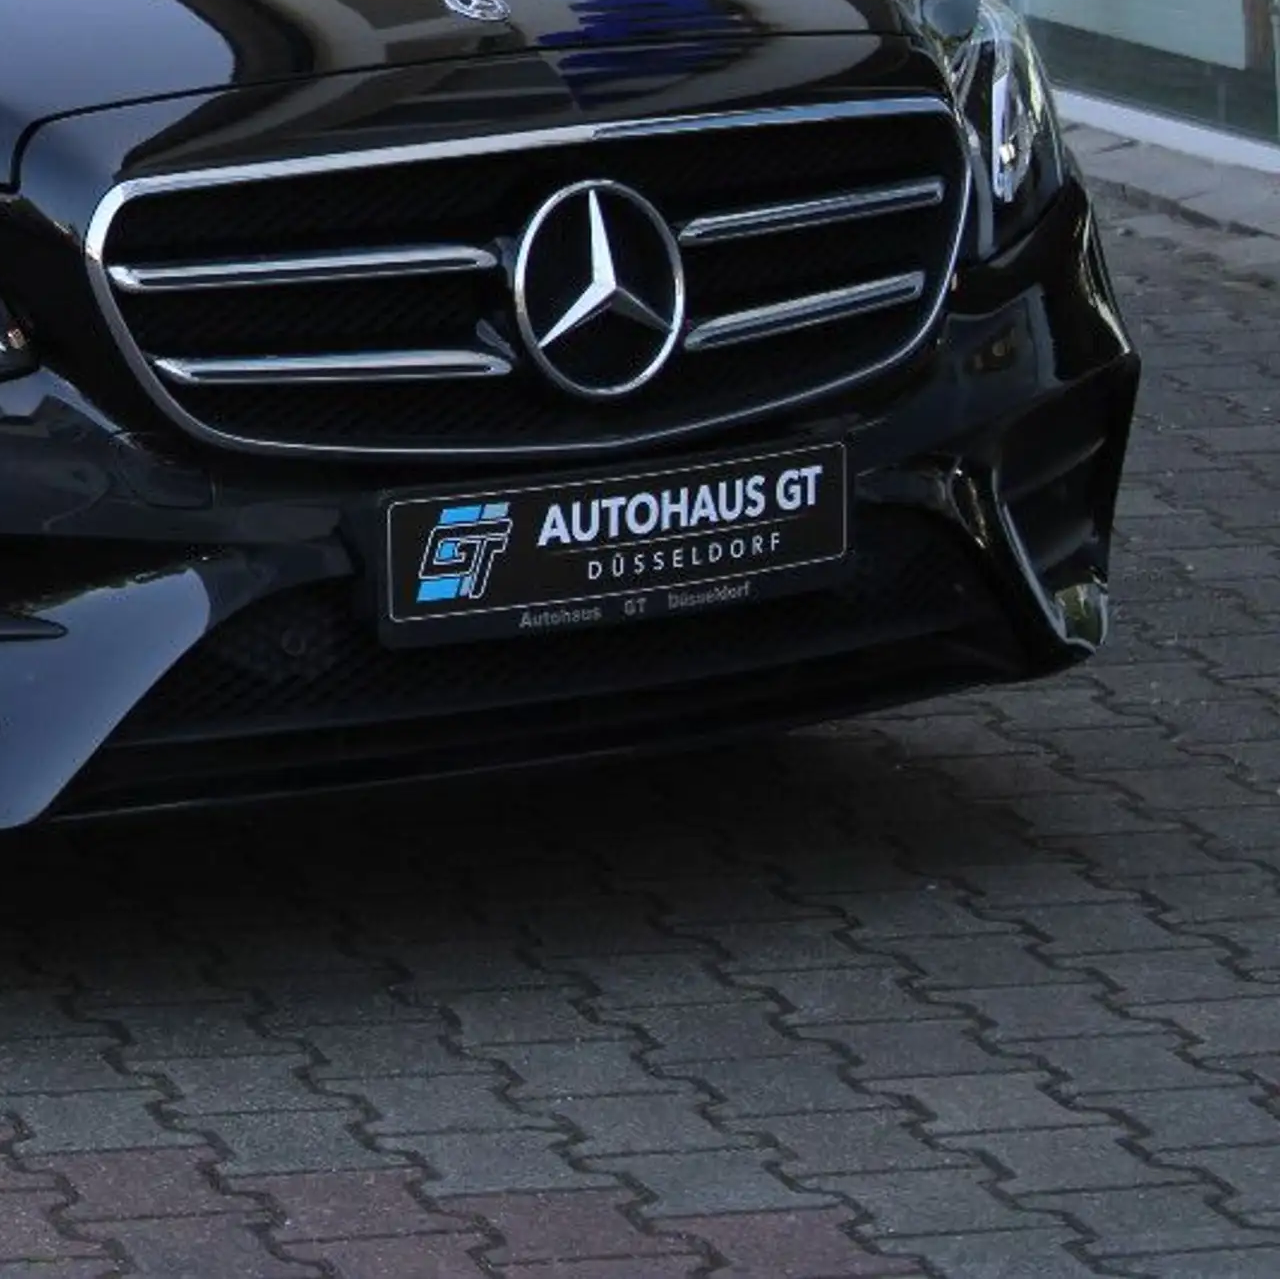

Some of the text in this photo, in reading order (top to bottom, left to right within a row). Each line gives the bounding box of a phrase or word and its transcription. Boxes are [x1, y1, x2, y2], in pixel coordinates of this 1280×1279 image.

[536, 465, 824, 547] AUTOHAUS GT
[587, 532, 781, 581] DÜSSELDORF
[519, 606, 603, 629] Autohaus
[624, 597, 647, 616] GT
